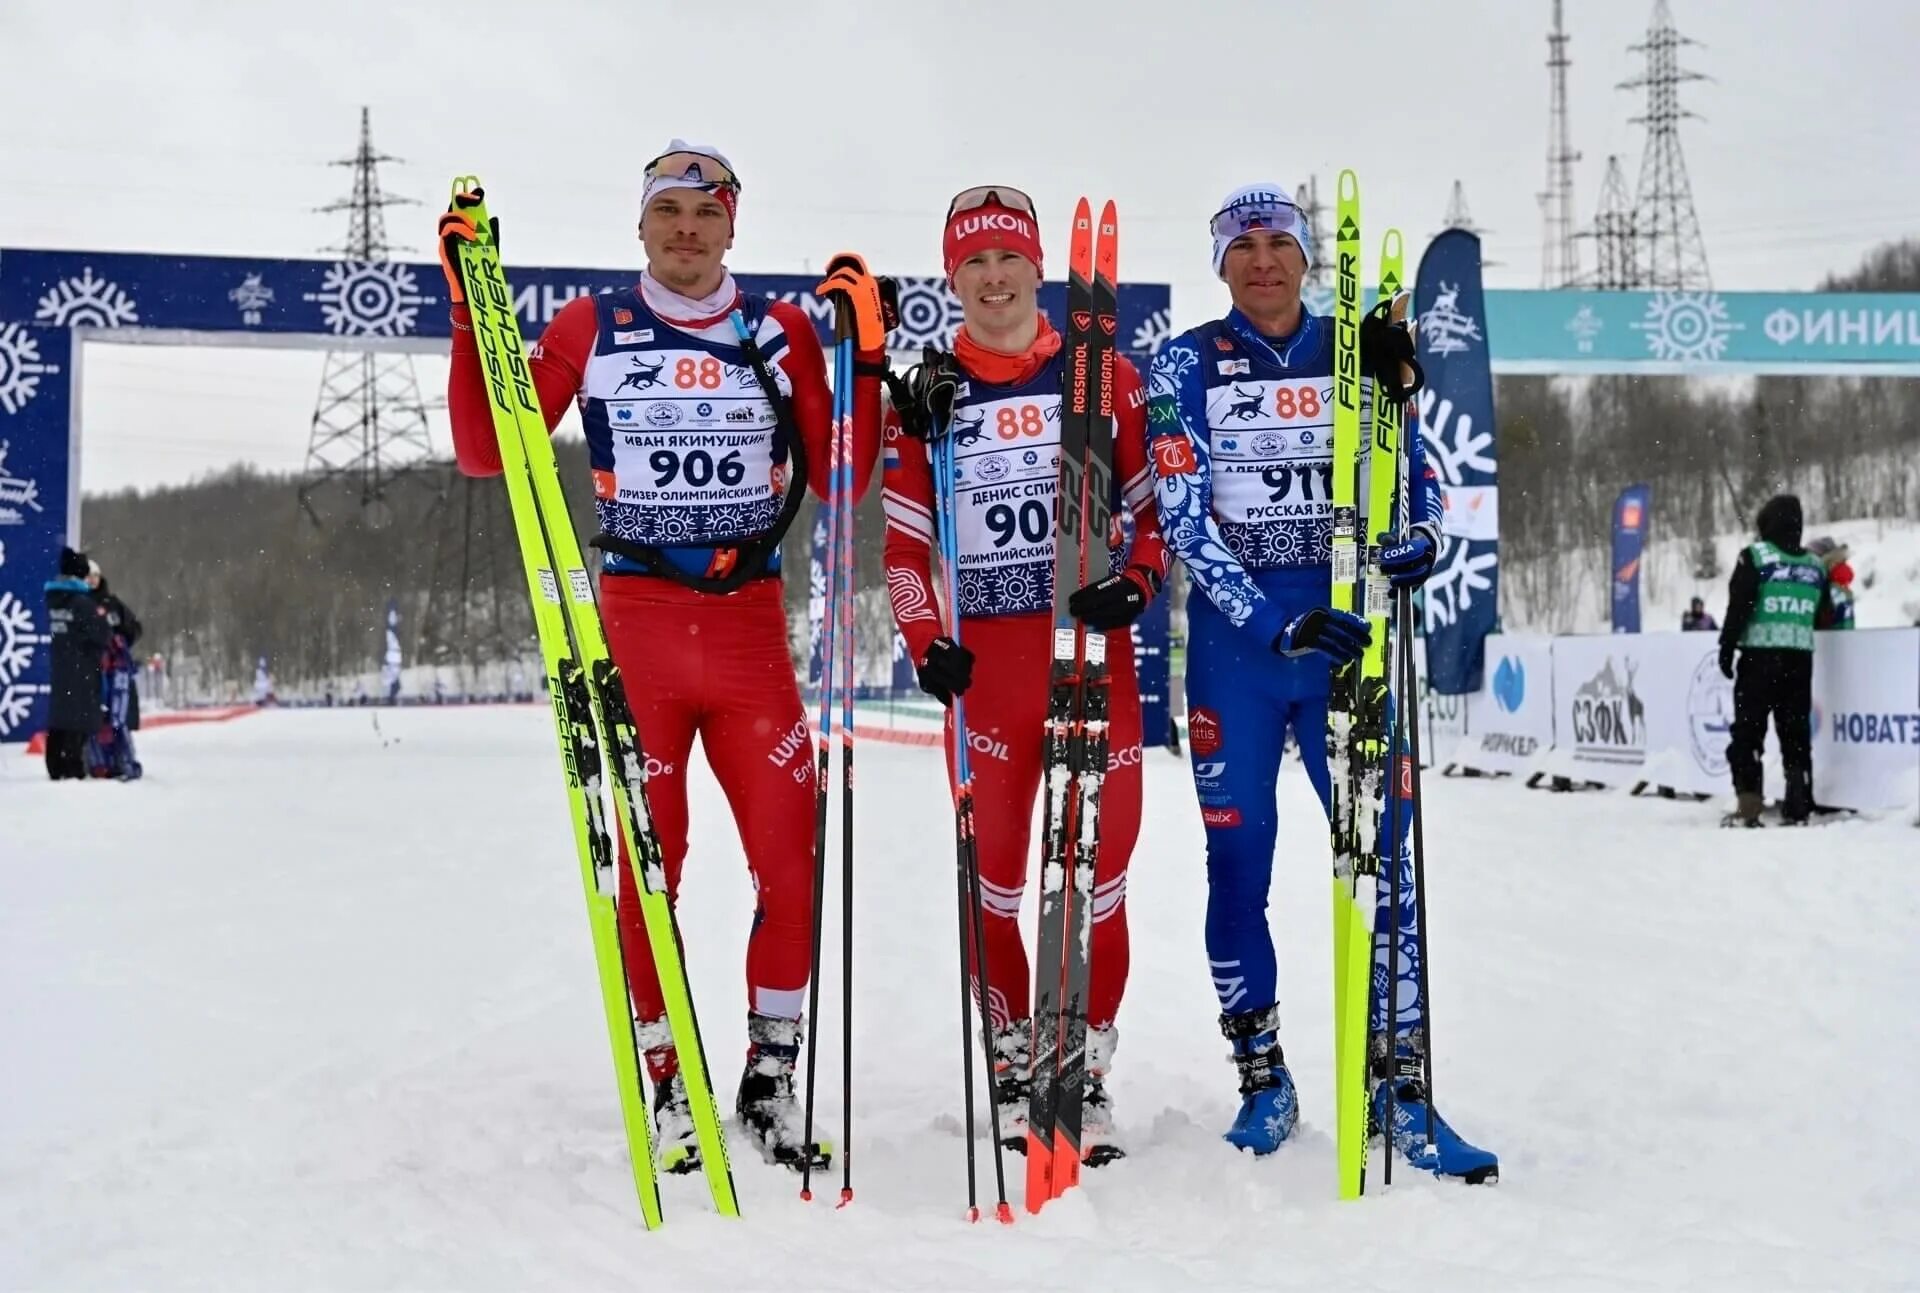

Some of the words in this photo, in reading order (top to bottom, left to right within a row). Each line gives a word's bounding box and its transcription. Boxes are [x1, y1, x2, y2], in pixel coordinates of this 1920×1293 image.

[955, 214, 1031, 240] LUKOIL
[465, 257, 512, 415] FISCHER
[481, 257, 538, 414] FISCHER
[1338, 252, 1356, 411] FISCHER
[674, 357, 722, 390] 88
[1073, 342, 1087, 414] ROSSIGNOL
[1100, 347, 1113, 417] ROSSIGNOL
[1276, 386, 1321, 420] 88
[996, 404, 1044, 440] 88
[625, 435, 664, 447] ИВАН
[668, 433, 766, 447] ЯКИМУШКИН
[648, 449, 746, 488] 906
[619, 489, 658, 501] ПРИЗЕР
[658, 486, 752, 501] ОЛИМПИЙСКИХ
[754, 484, 769, 496] ИГР
[971, 485, 1022, 506] ДЕНИС
[1024, 480, 1059, 497] СПИ
[985, 497, 1057, 549] 90
[1246, 504, 1313, 519] РУССКАЯ
[959, 542, 1055, 565] ОЛИМПИЙСКИЙ
[1384, 544, 1415, 559] COXA
[551, 676, 578, 789] FISCHER
[1572, 699, 1627, 745] СЗФК
[965, 727, 1009, 761] KOIL
